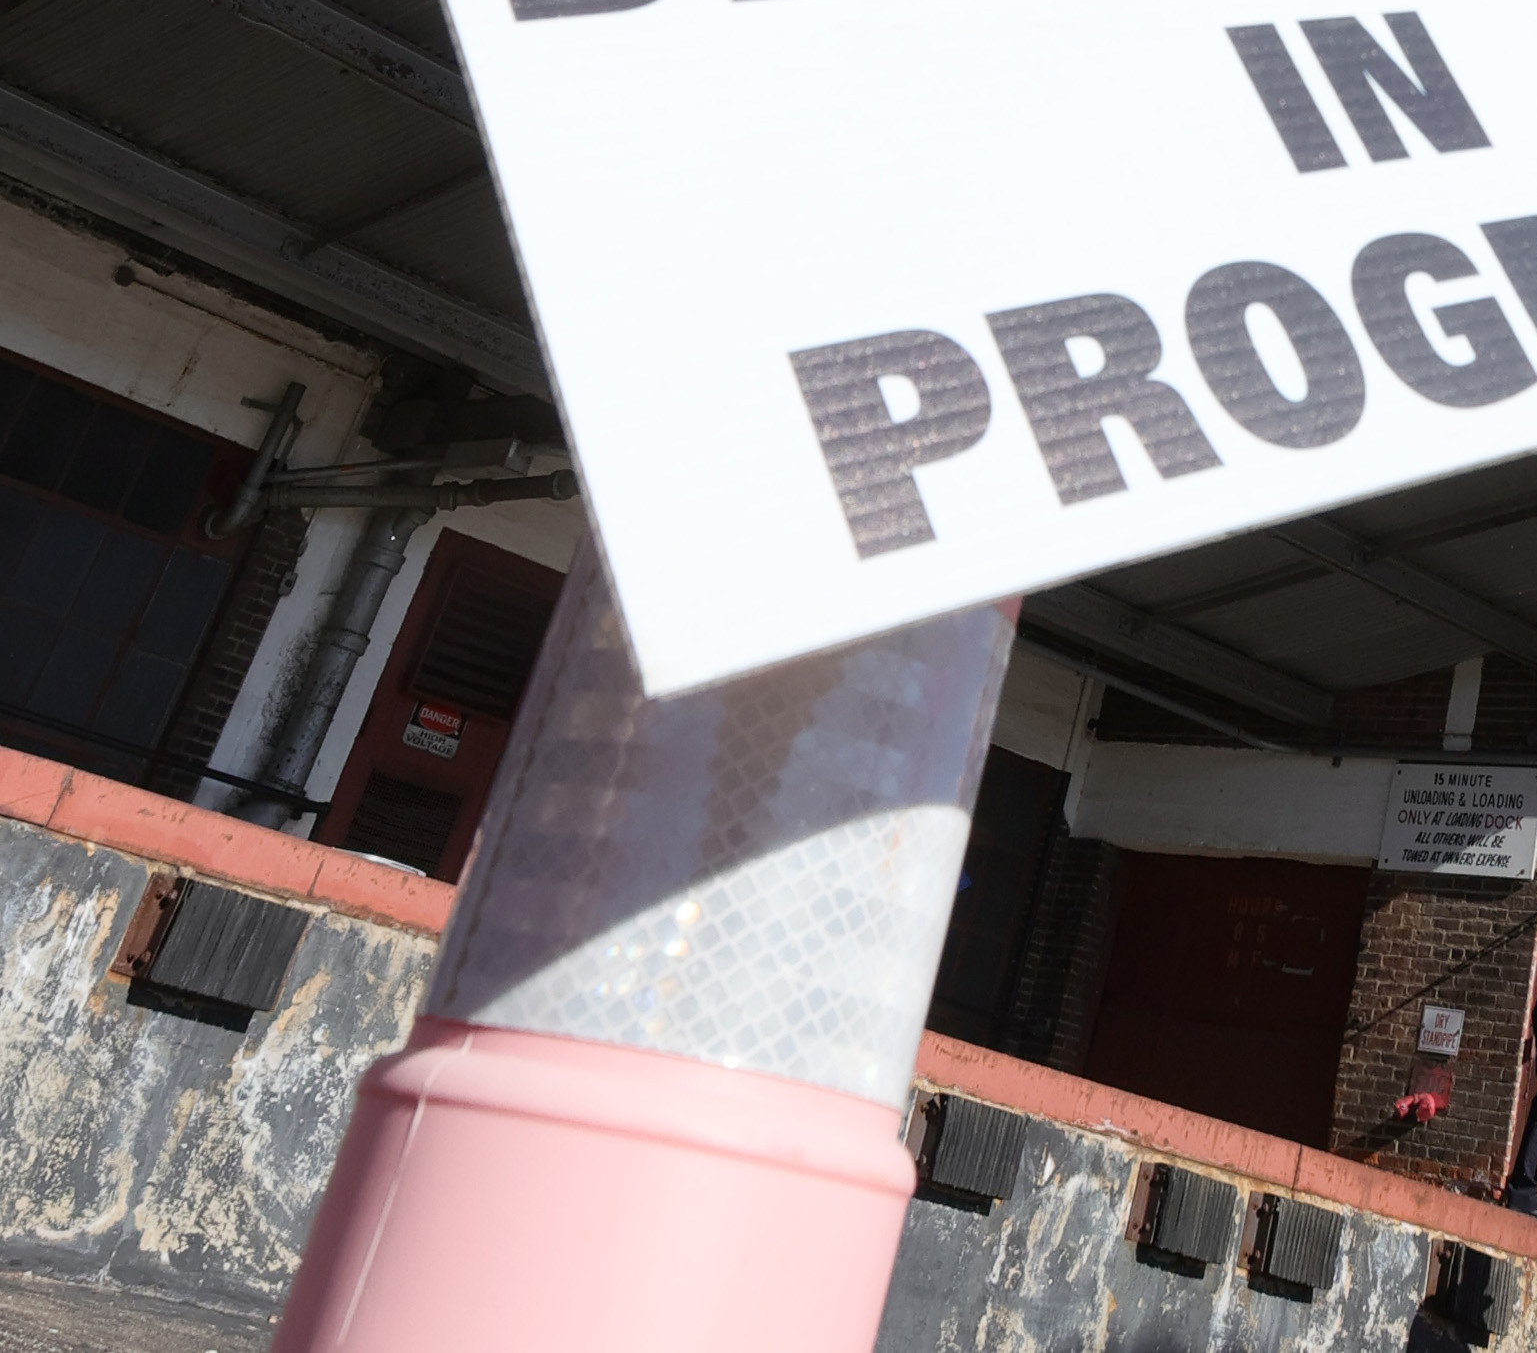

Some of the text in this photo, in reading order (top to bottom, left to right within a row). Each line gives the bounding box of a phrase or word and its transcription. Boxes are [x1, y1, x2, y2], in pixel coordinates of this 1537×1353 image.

[1226, 12, 1489, 172] IN
[420, 708, 460, 728] DANGER
[407, 734, 453, 754] VOLTAGE
[420, 731, 446, 744] HIGH
[1434, 772, 1492, 787] 15 MINUTE
[1403, 790, 1524, 809] UNLOADING & LOADING
[1398, 810, 1524, 831] ONLY AT LOADING DOCK
[1415, 831, 1506, 849] ALL OTHERS WILL BE
[1402, 849, 1512, 868] TOWED AT OWNERS EXPENSE
[1435, 1012, 1451, 1029] DRY
[1421, 1030, 1456, 1050] STANDPIPE
